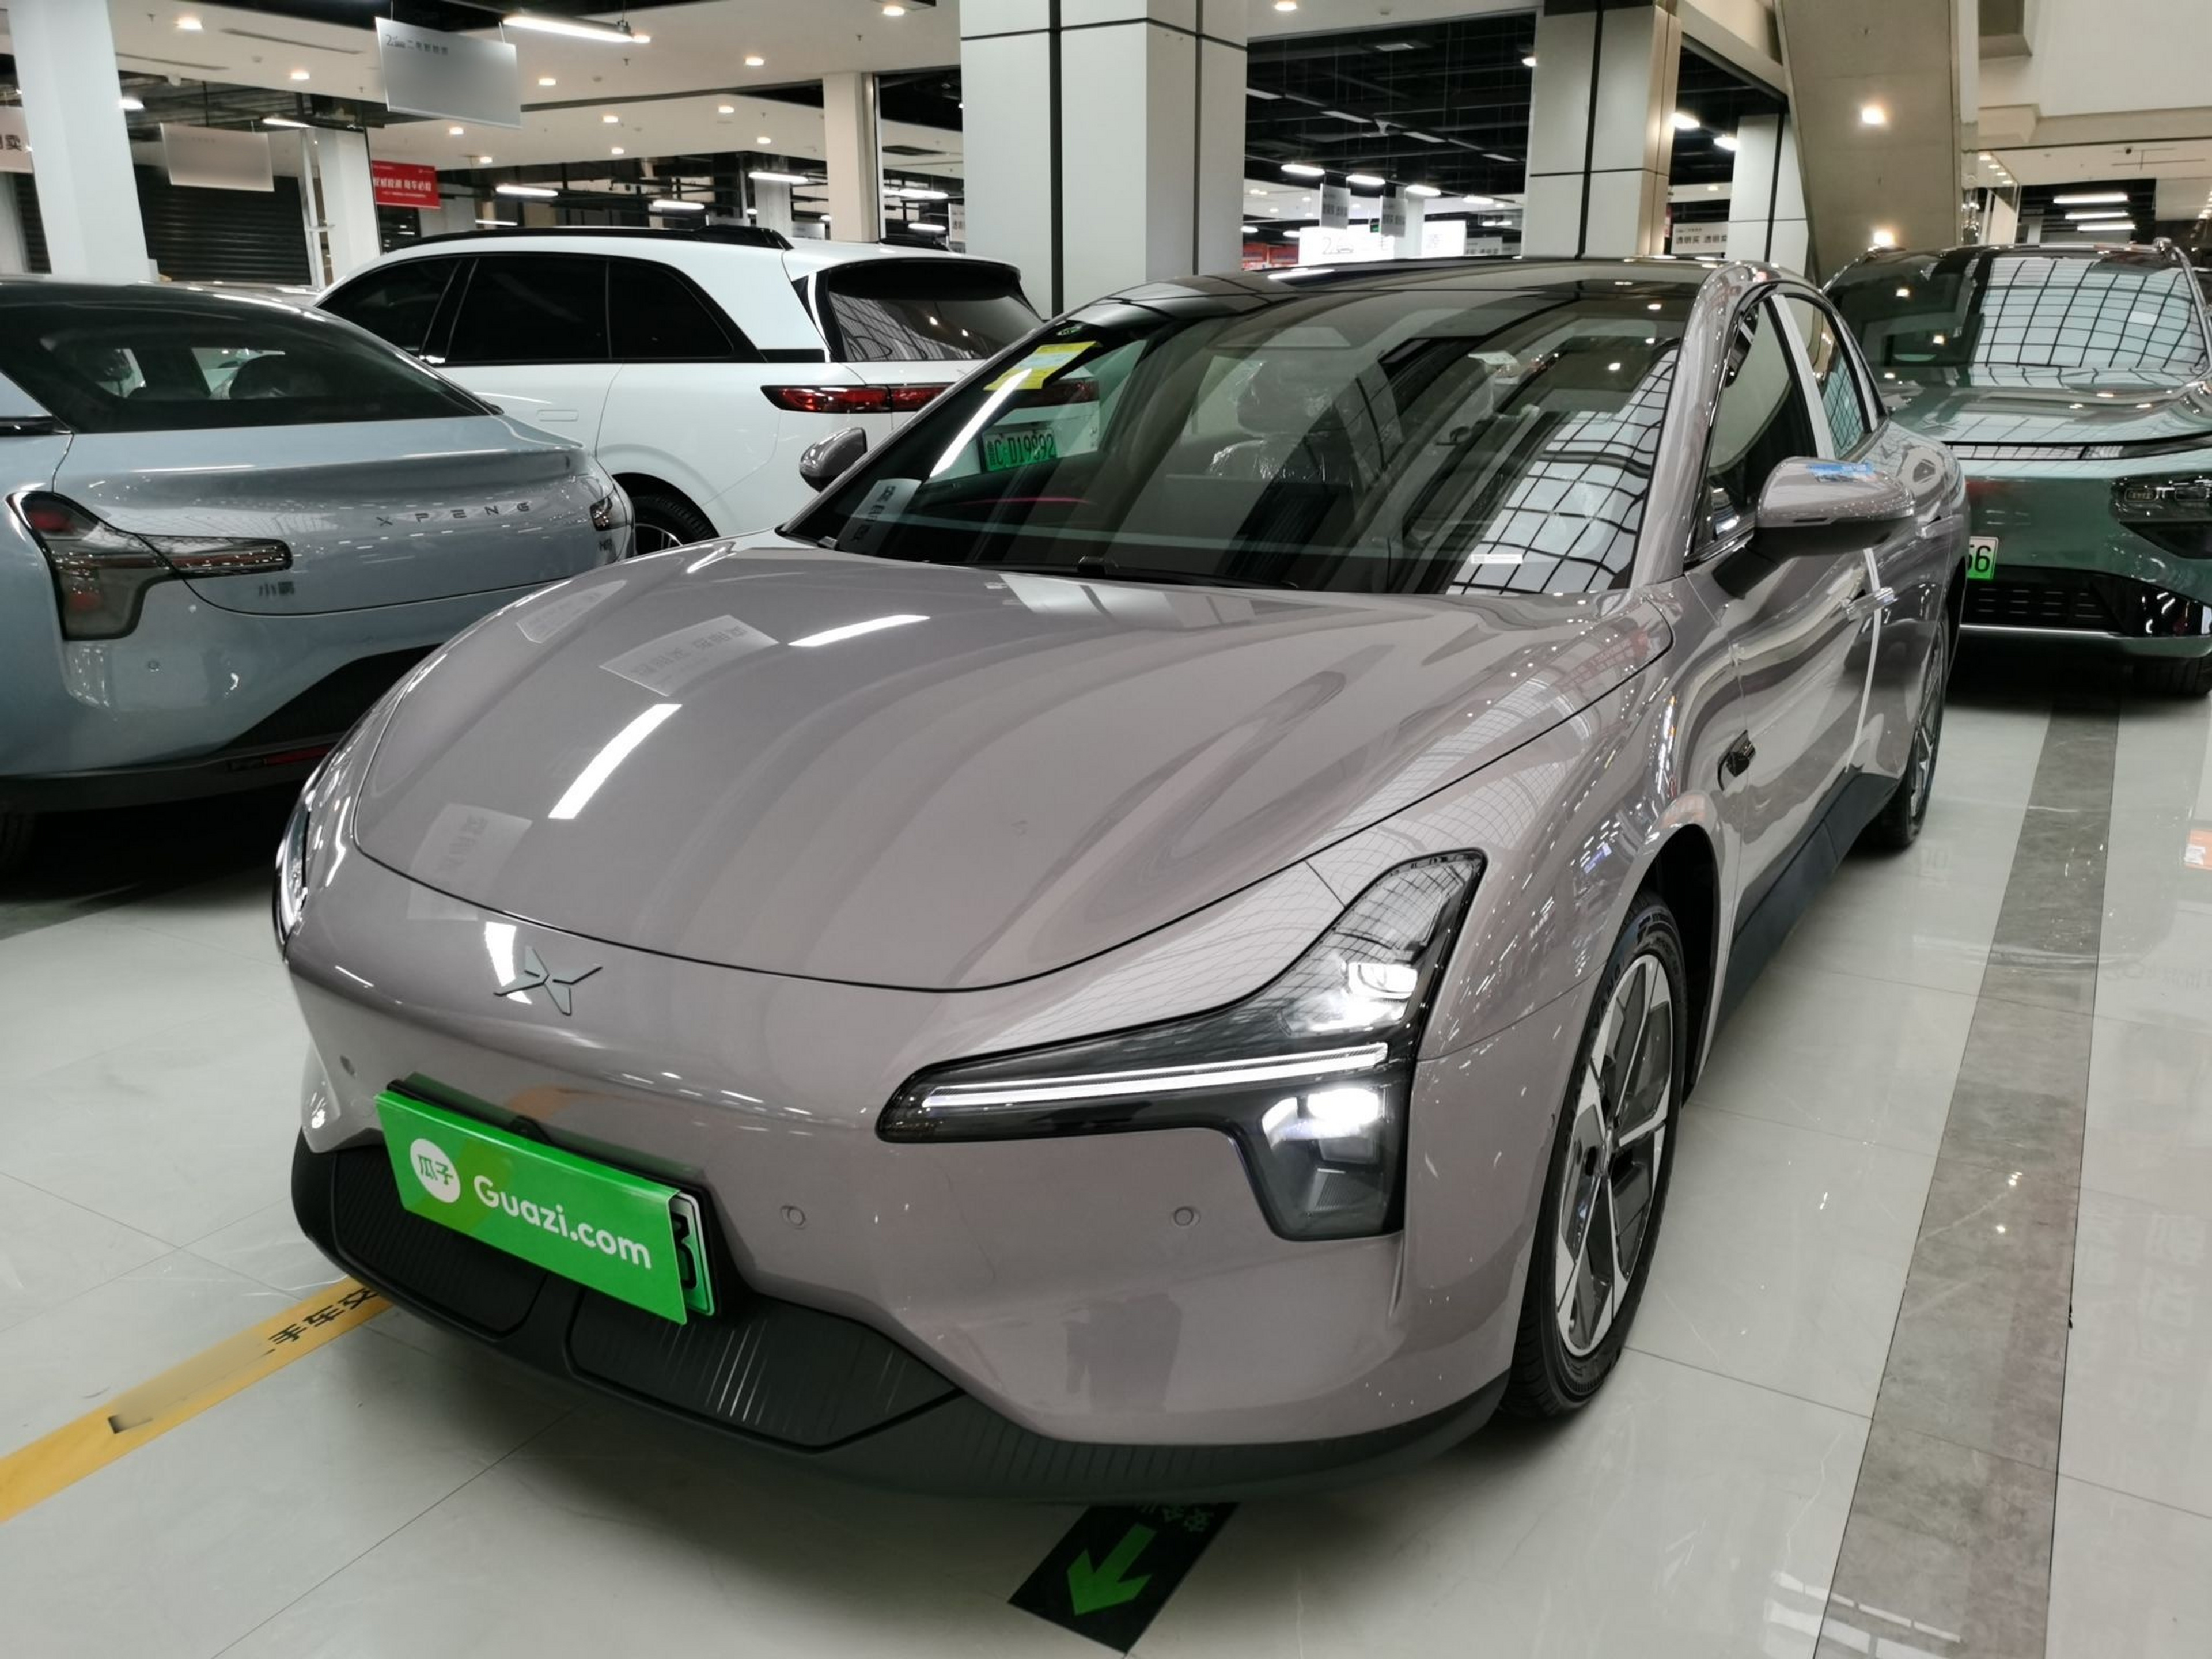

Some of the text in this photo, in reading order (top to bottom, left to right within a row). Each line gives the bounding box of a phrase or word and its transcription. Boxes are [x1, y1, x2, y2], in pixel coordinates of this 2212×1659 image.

[376, 501, 531, 527] XPENG
[417, 1155, 454, 1186] 瓜子
[473, 1175, 652, 1270] Guazi.com
